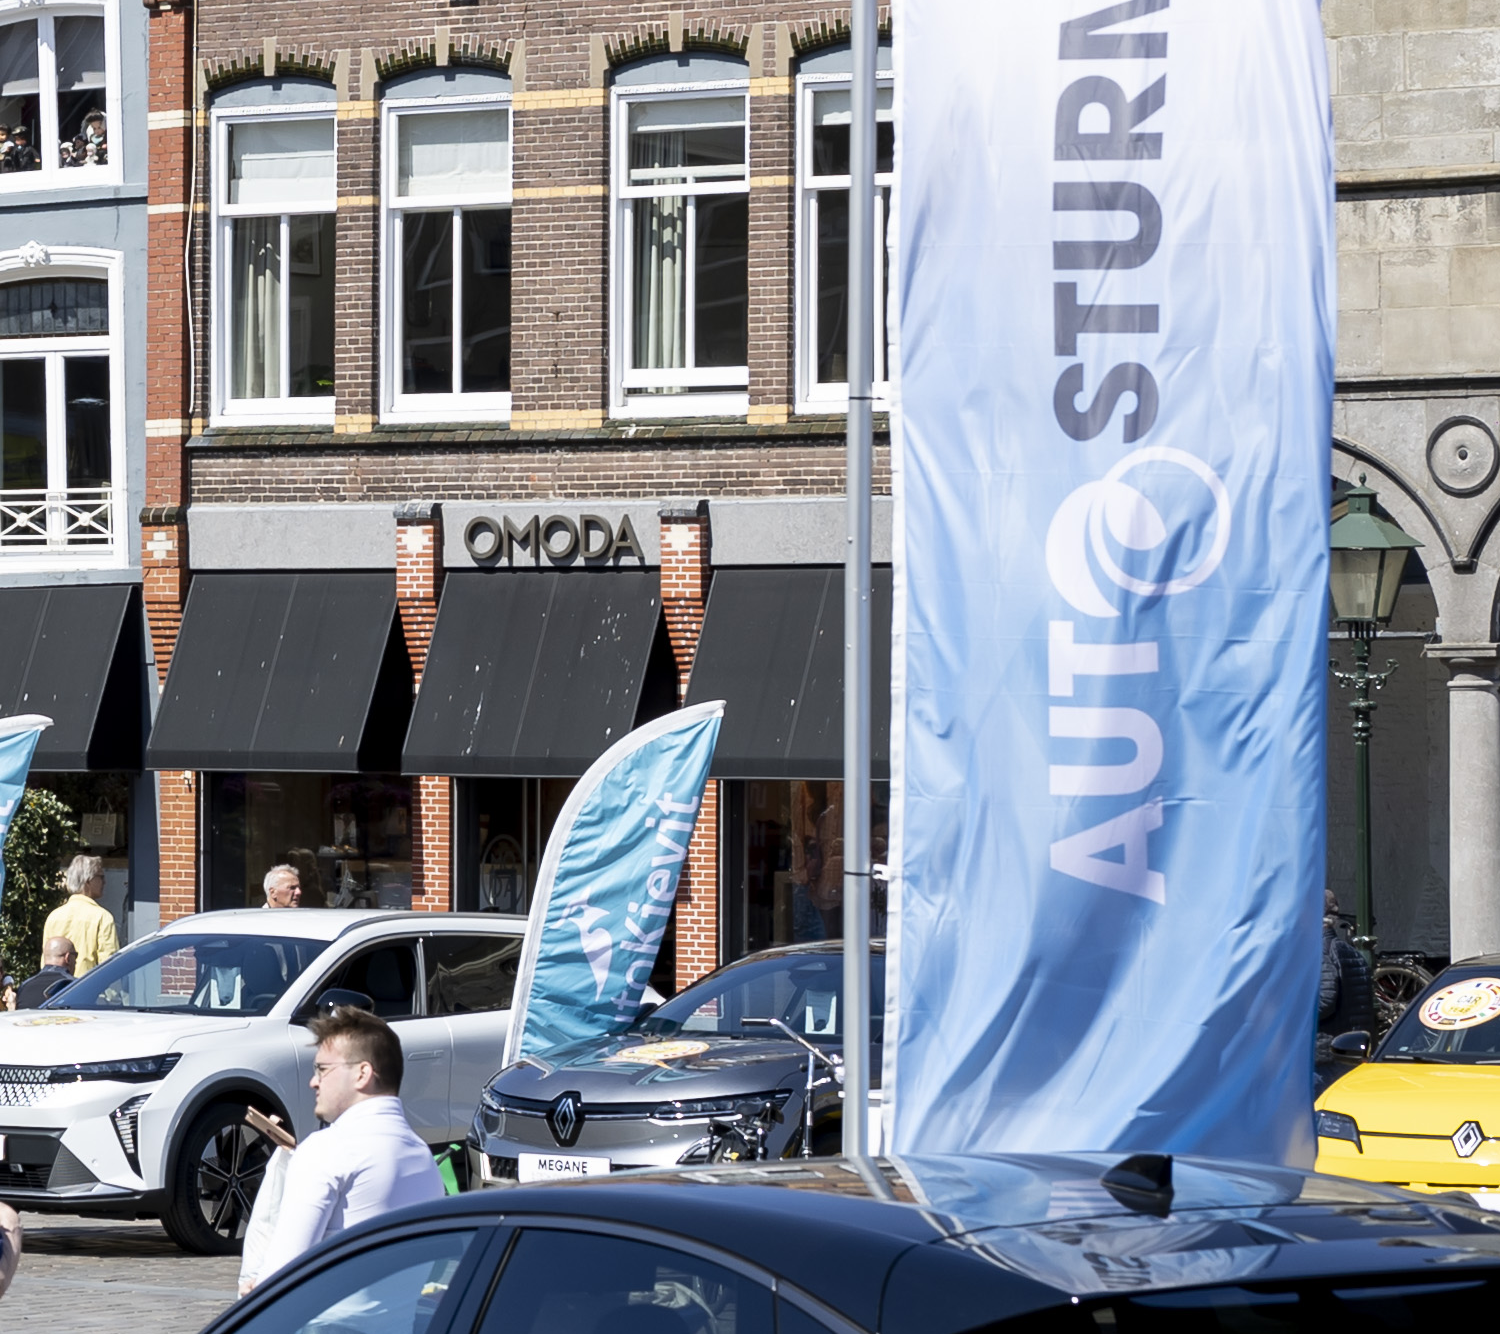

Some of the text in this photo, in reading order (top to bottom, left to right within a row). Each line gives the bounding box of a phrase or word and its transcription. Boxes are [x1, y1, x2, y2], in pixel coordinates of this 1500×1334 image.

[464, 514, 644, 559] OMODA
[611, 792, 699, 1022] toKievit
[538, 1159, 588, 1174] MEGANE
